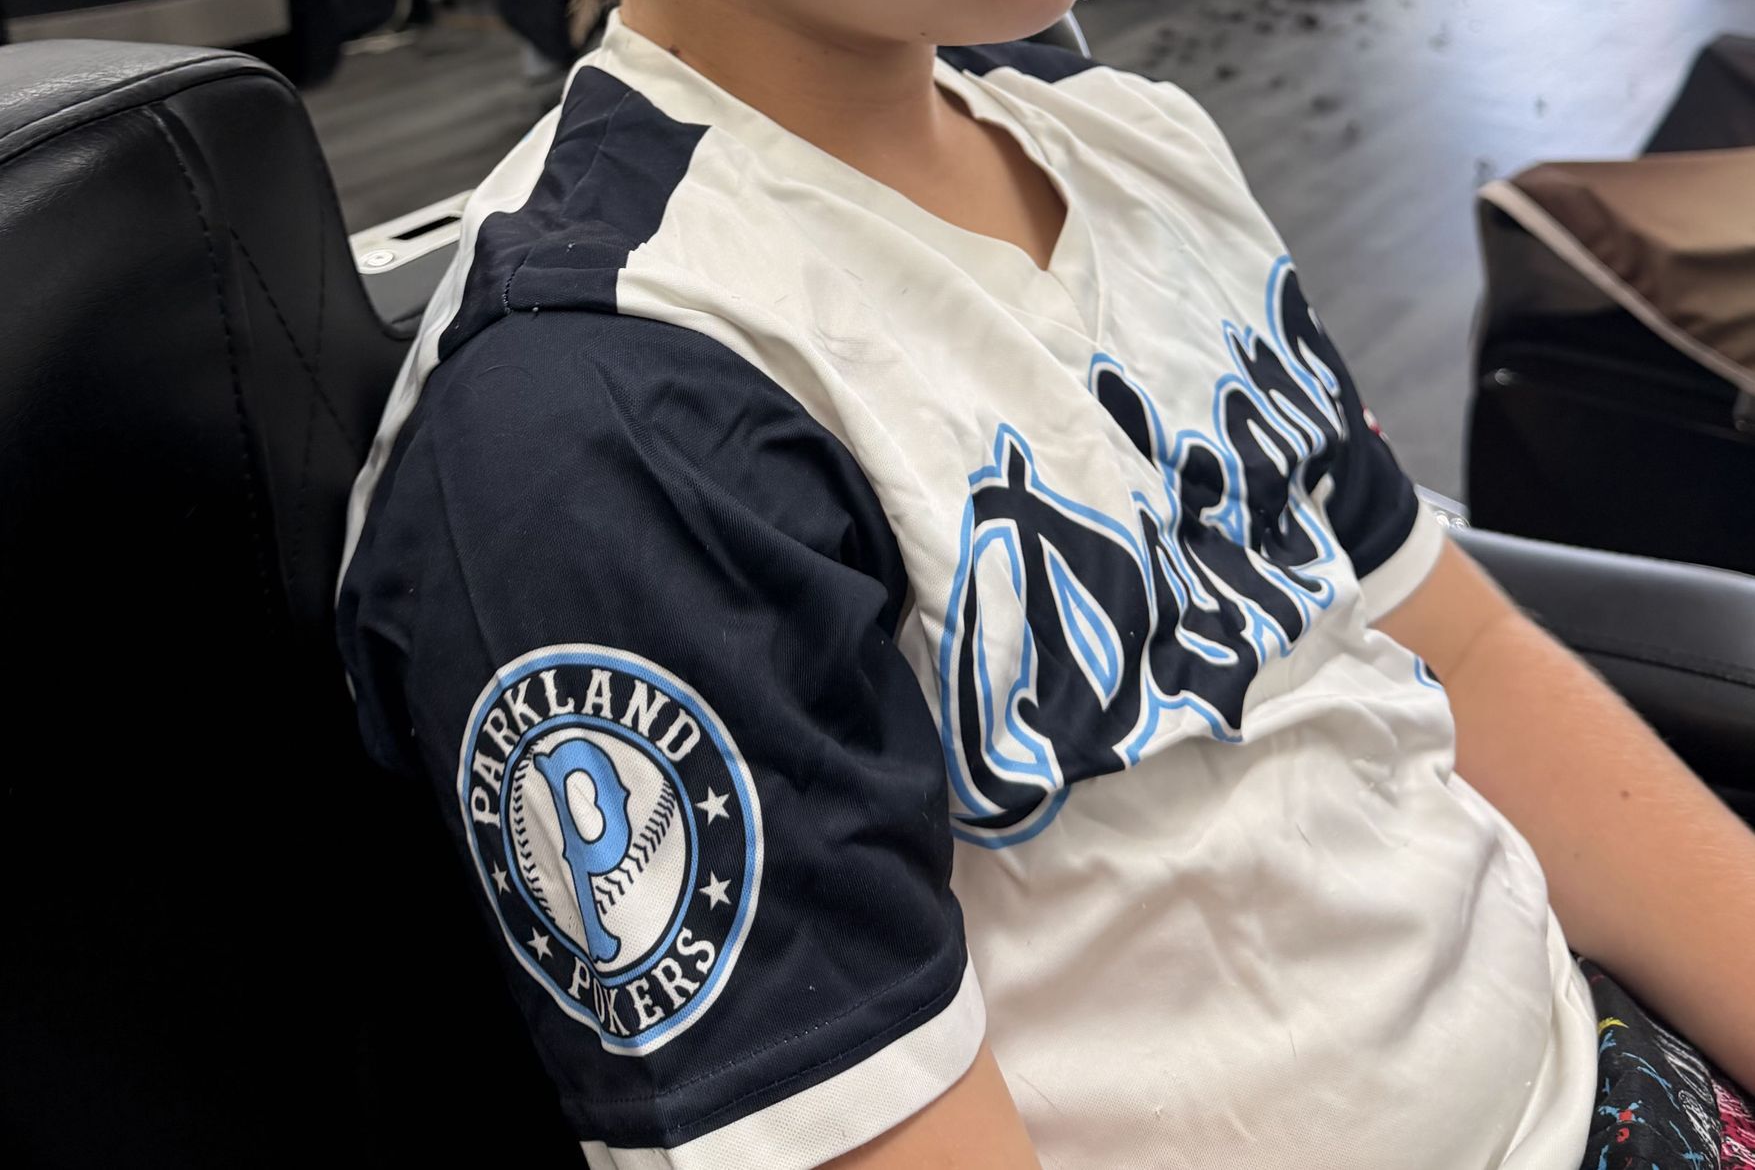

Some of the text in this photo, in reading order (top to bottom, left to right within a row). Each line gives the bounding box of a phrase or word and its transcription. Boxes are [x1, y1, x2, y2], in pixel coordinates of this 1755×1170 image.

[470, 668, 702, 829] PARKLAND
[533, 738, 632, 964] P
[567, 926, 717, 1037] POKERS
